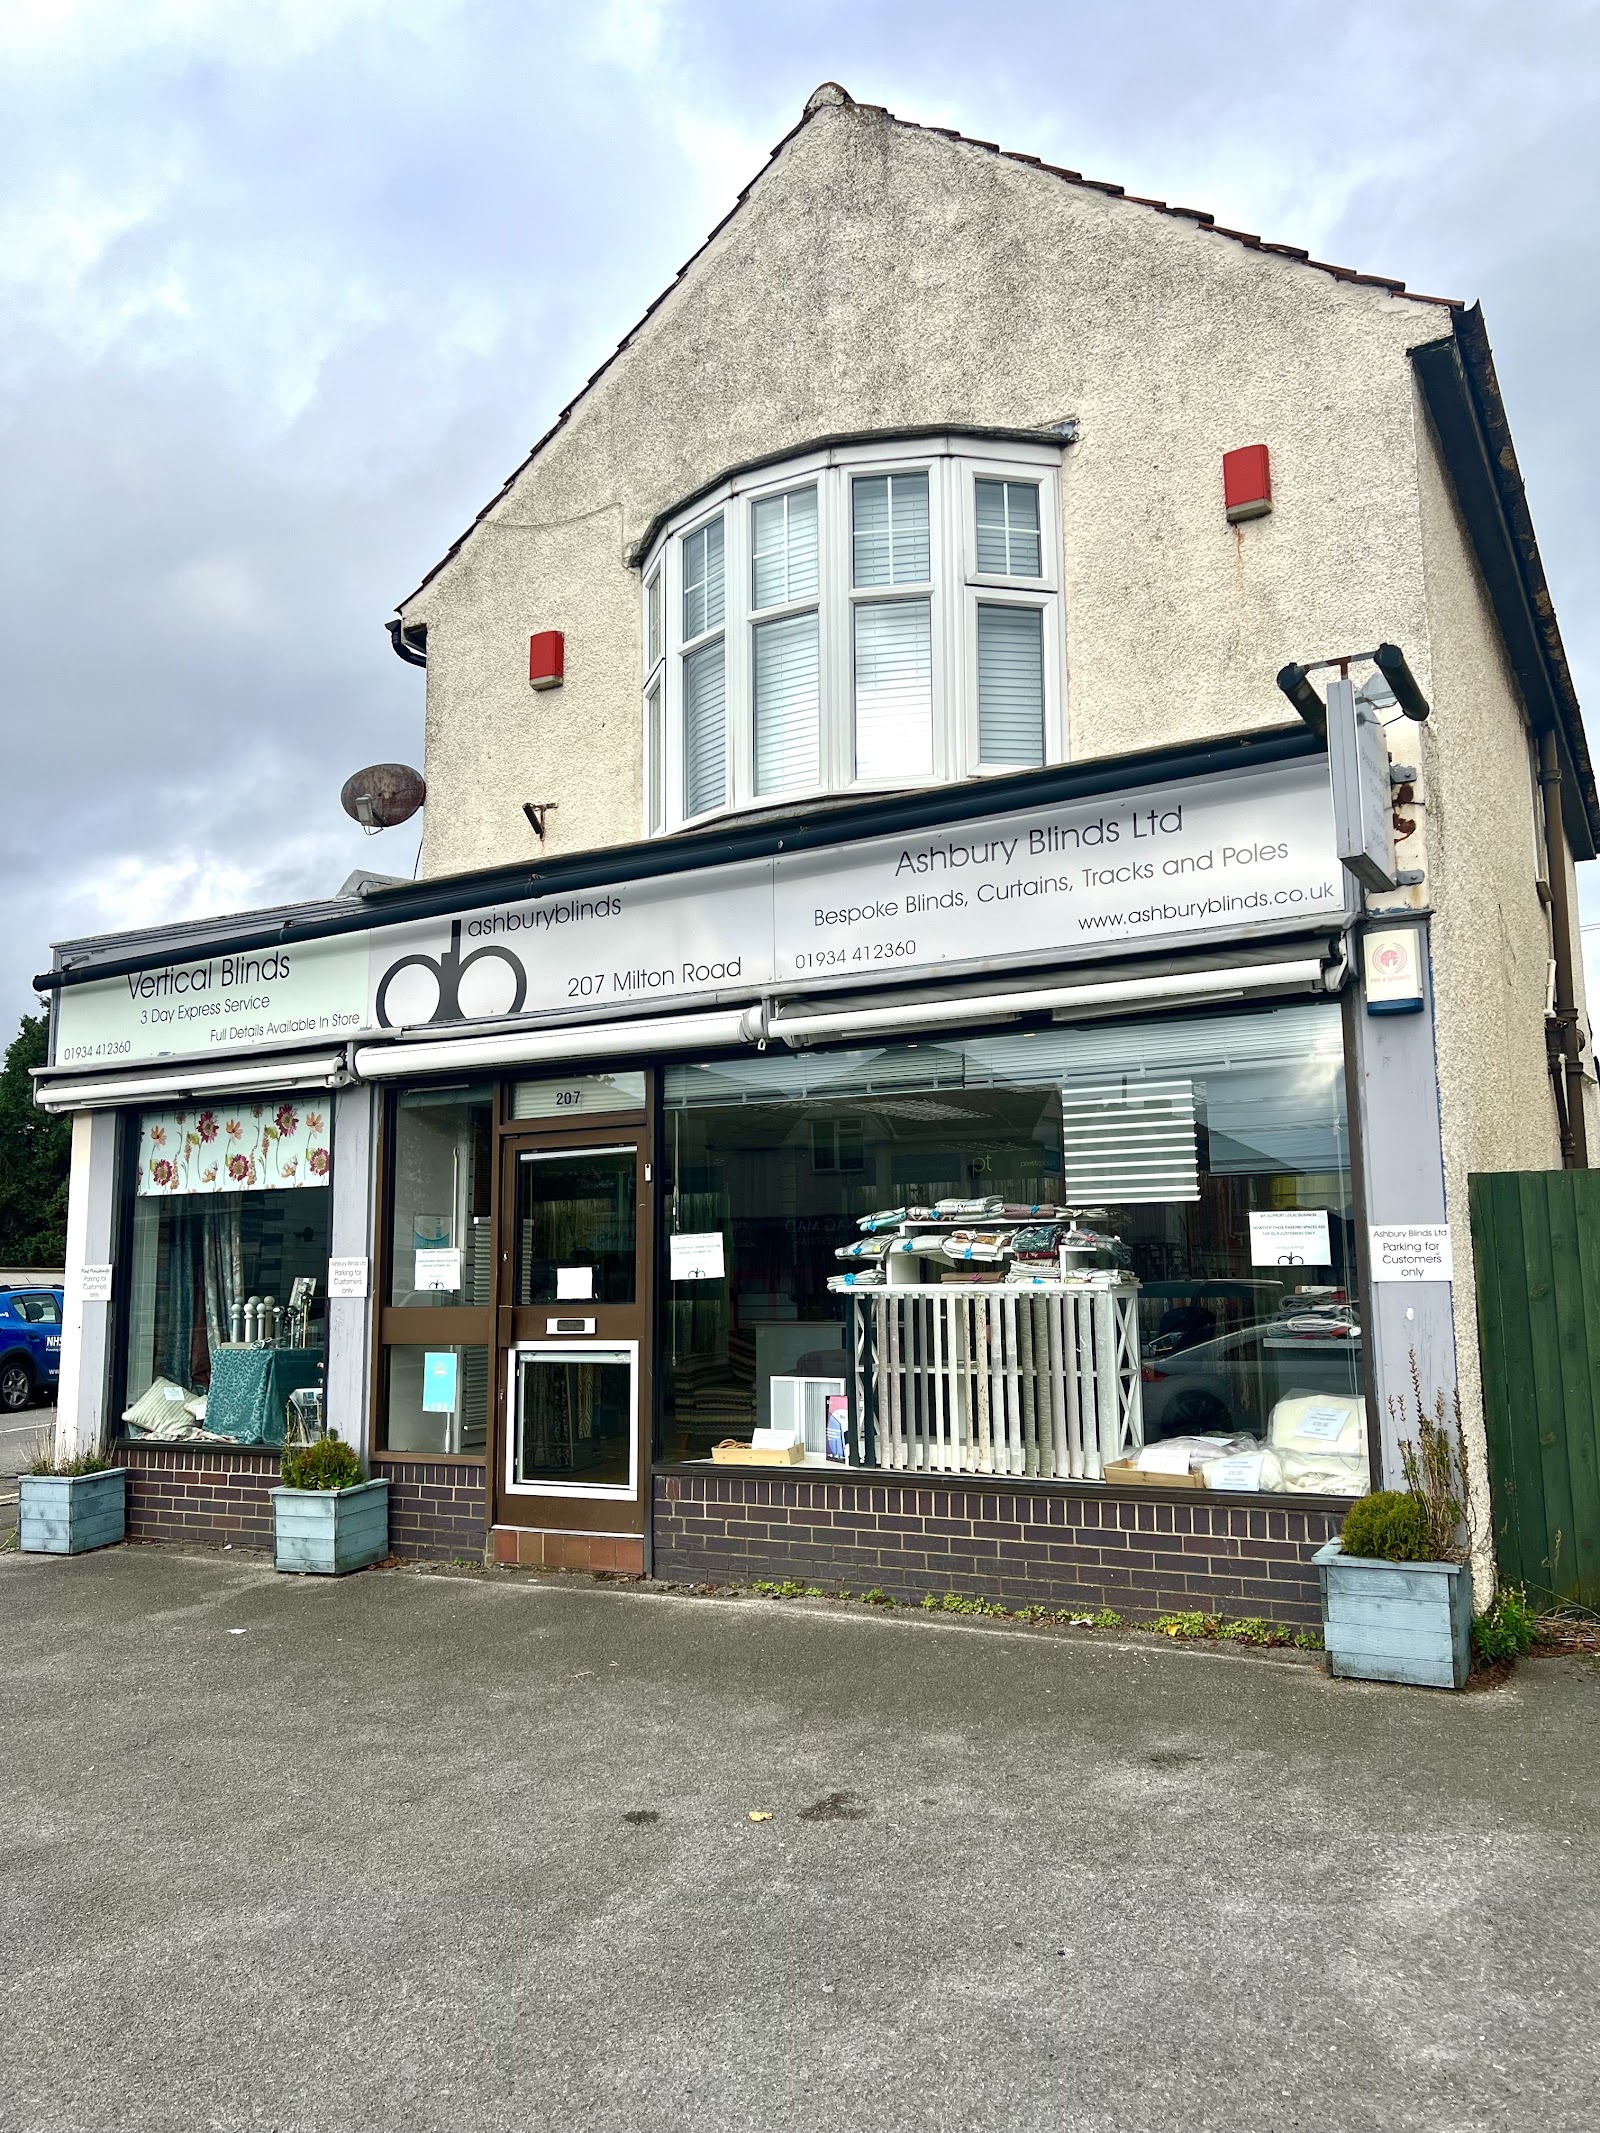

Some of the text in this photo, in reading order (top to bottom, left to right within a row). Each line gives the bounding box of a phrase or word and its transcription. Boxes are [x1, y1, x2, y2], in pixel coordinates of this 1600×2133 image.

[895, 805, 1183, 877] Ashbury Blinds Ltd
[814, 843, 1289, 926] Bespoke Blinds, Curtains, Tracks and Poles
[468, 895, 621, 937] ashburyblinds
[1078, 882, 1334, 930] www.ashburyblinds.co.uk
[795, 940, 917, 969] 01934 412360
[127, 951, 290, 1000] Vertical Blinds
[568, 956, 741, 997] 207 Milton Road
[140, 996, 270, 1025] 3 Day Express Service
[210, 1013, 360, 1042] Full Details Available In Store
[64, 1040, 131, 1060] 01934 412360
[556, 1090, 581, 1105] 207
[972, 1154, 992, 1178] pt
[1373, 1230, 1406, 1238] Ashbury
[1408, 1229, 1432, 1237] Blinds
[1383, 1241, 1439, 1252] Parking for
[334, 1269, 353, 1277] Parking
[1382, 1254, 1441, 1264] Customers
[1401, 1267, 1424, 1277] only
